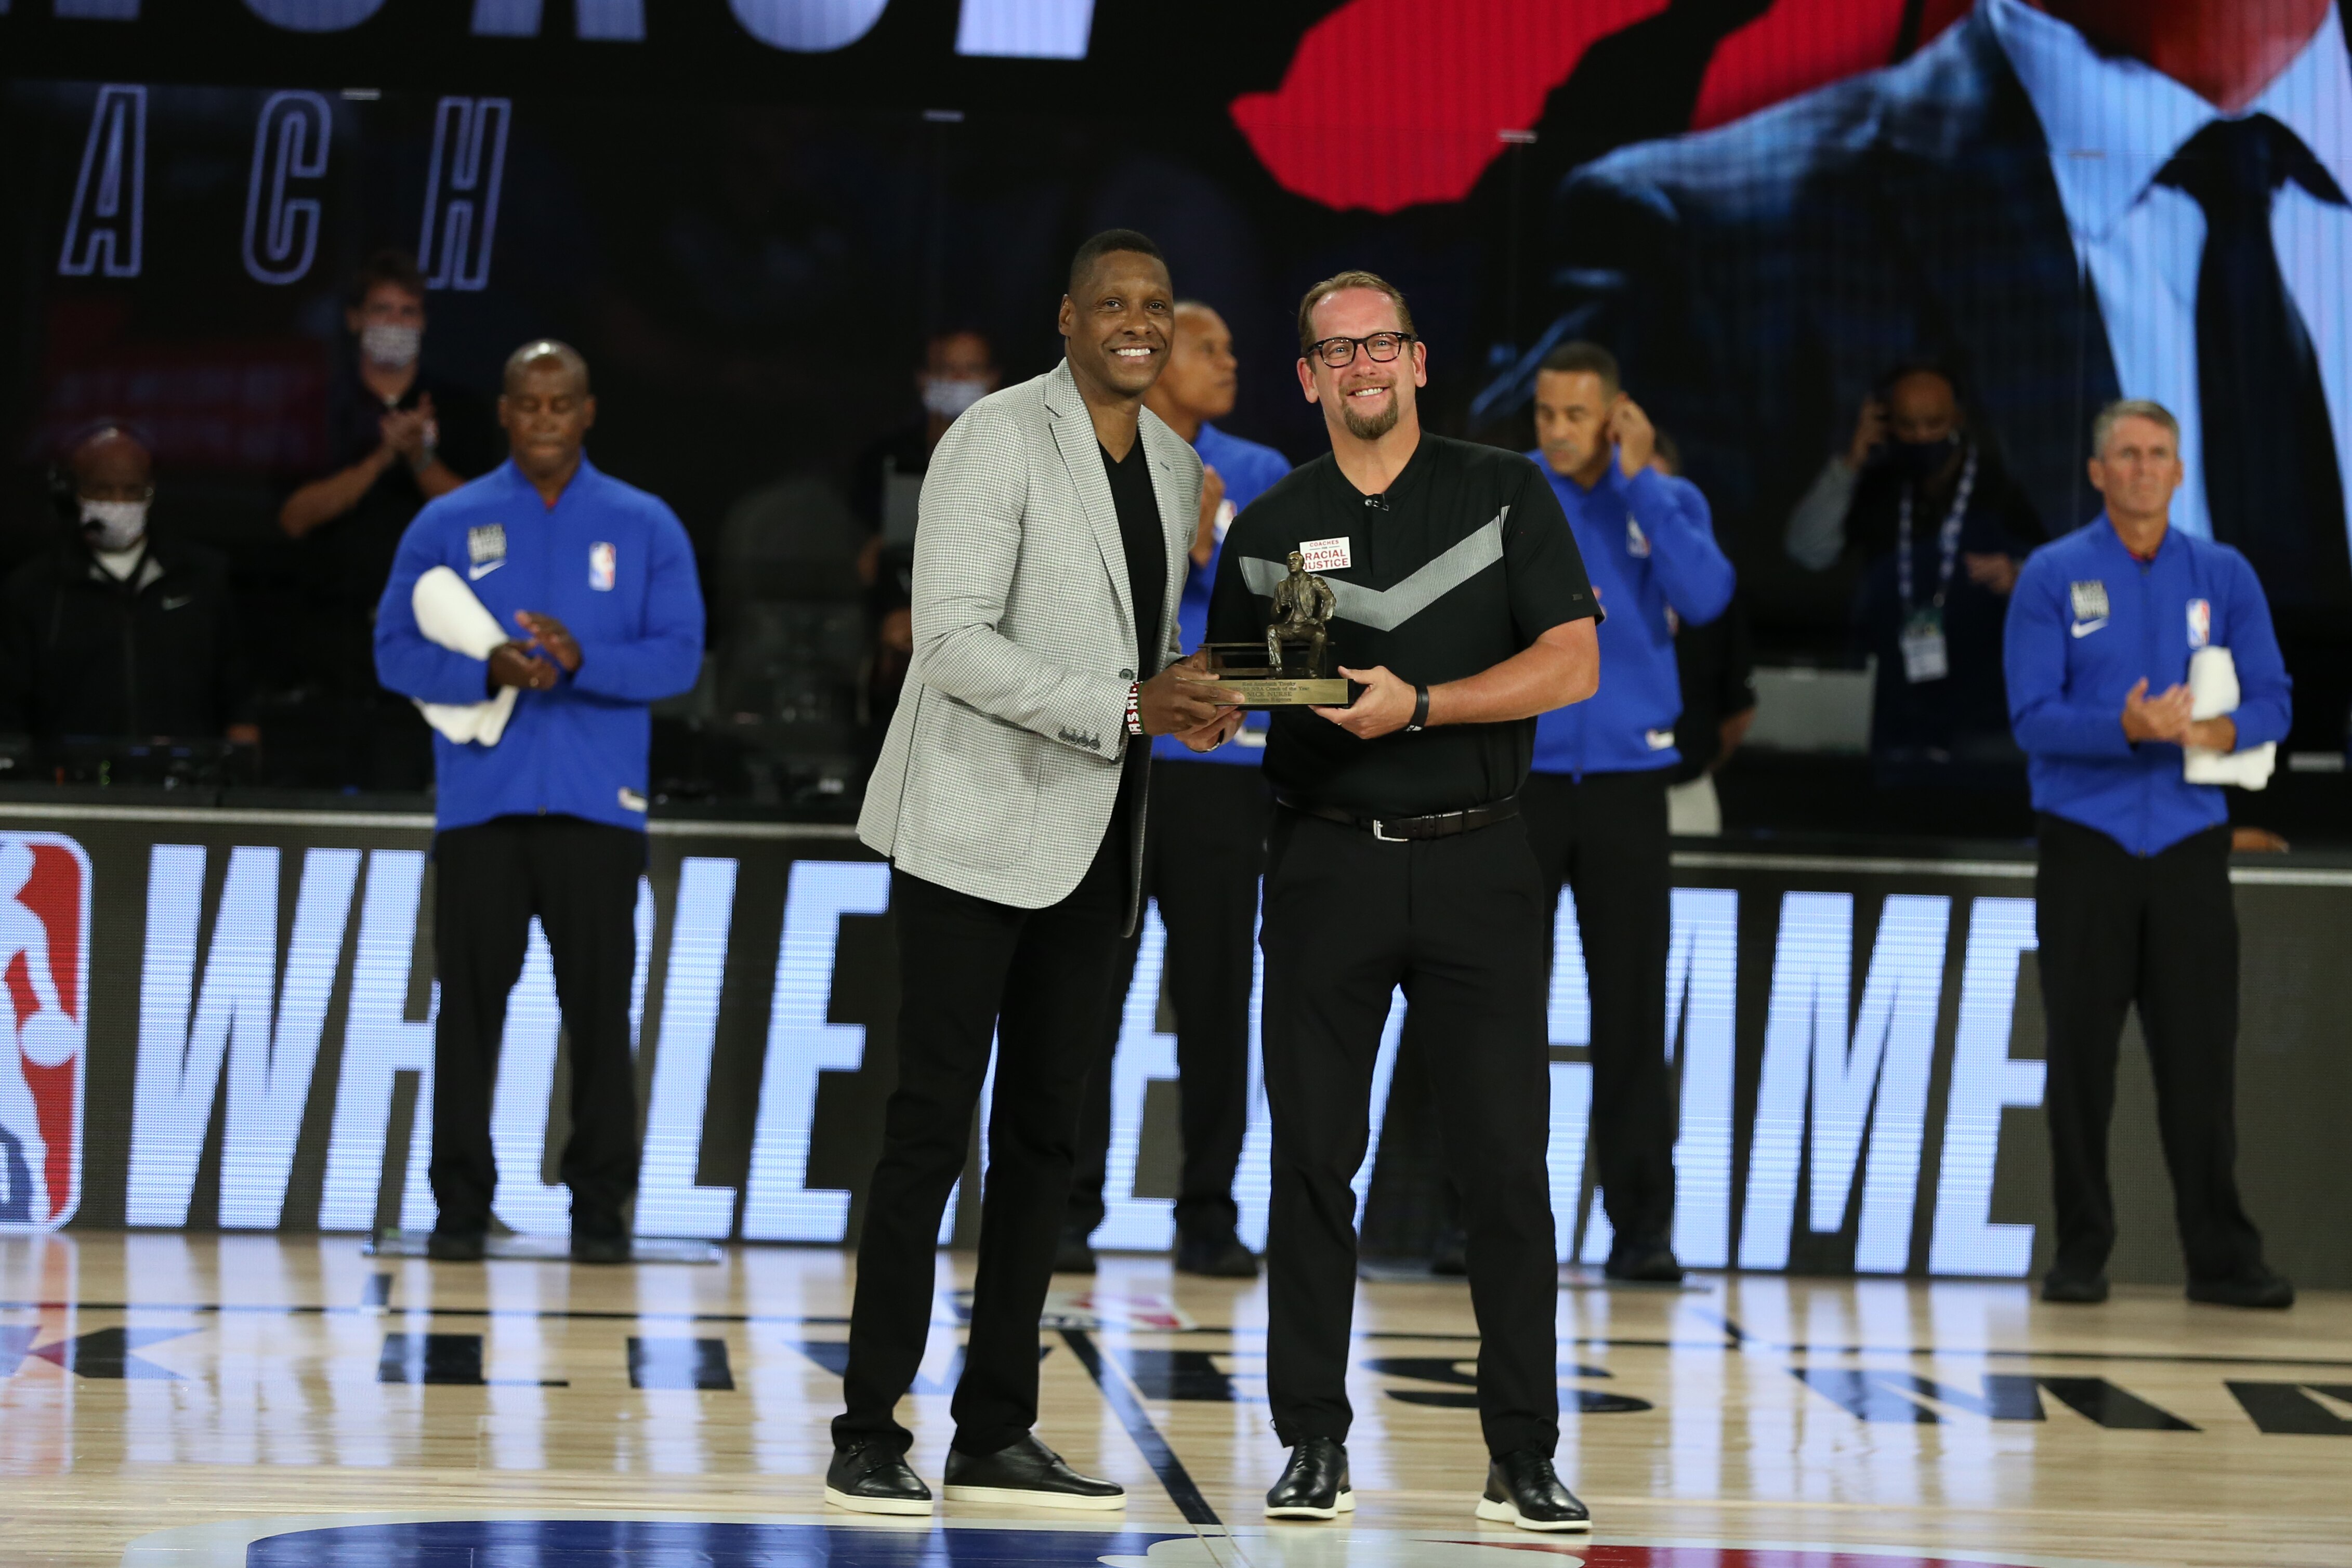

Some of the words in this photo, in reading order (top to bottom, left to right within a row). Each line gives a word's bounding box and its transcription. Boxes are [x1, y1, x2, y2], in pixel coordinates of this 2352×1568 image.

[1305, 549, 1346, 561] RACIAL
[1304, 558, 1349, 570] JUSTICE
[1126, 693, 1144, 735] ASAI
